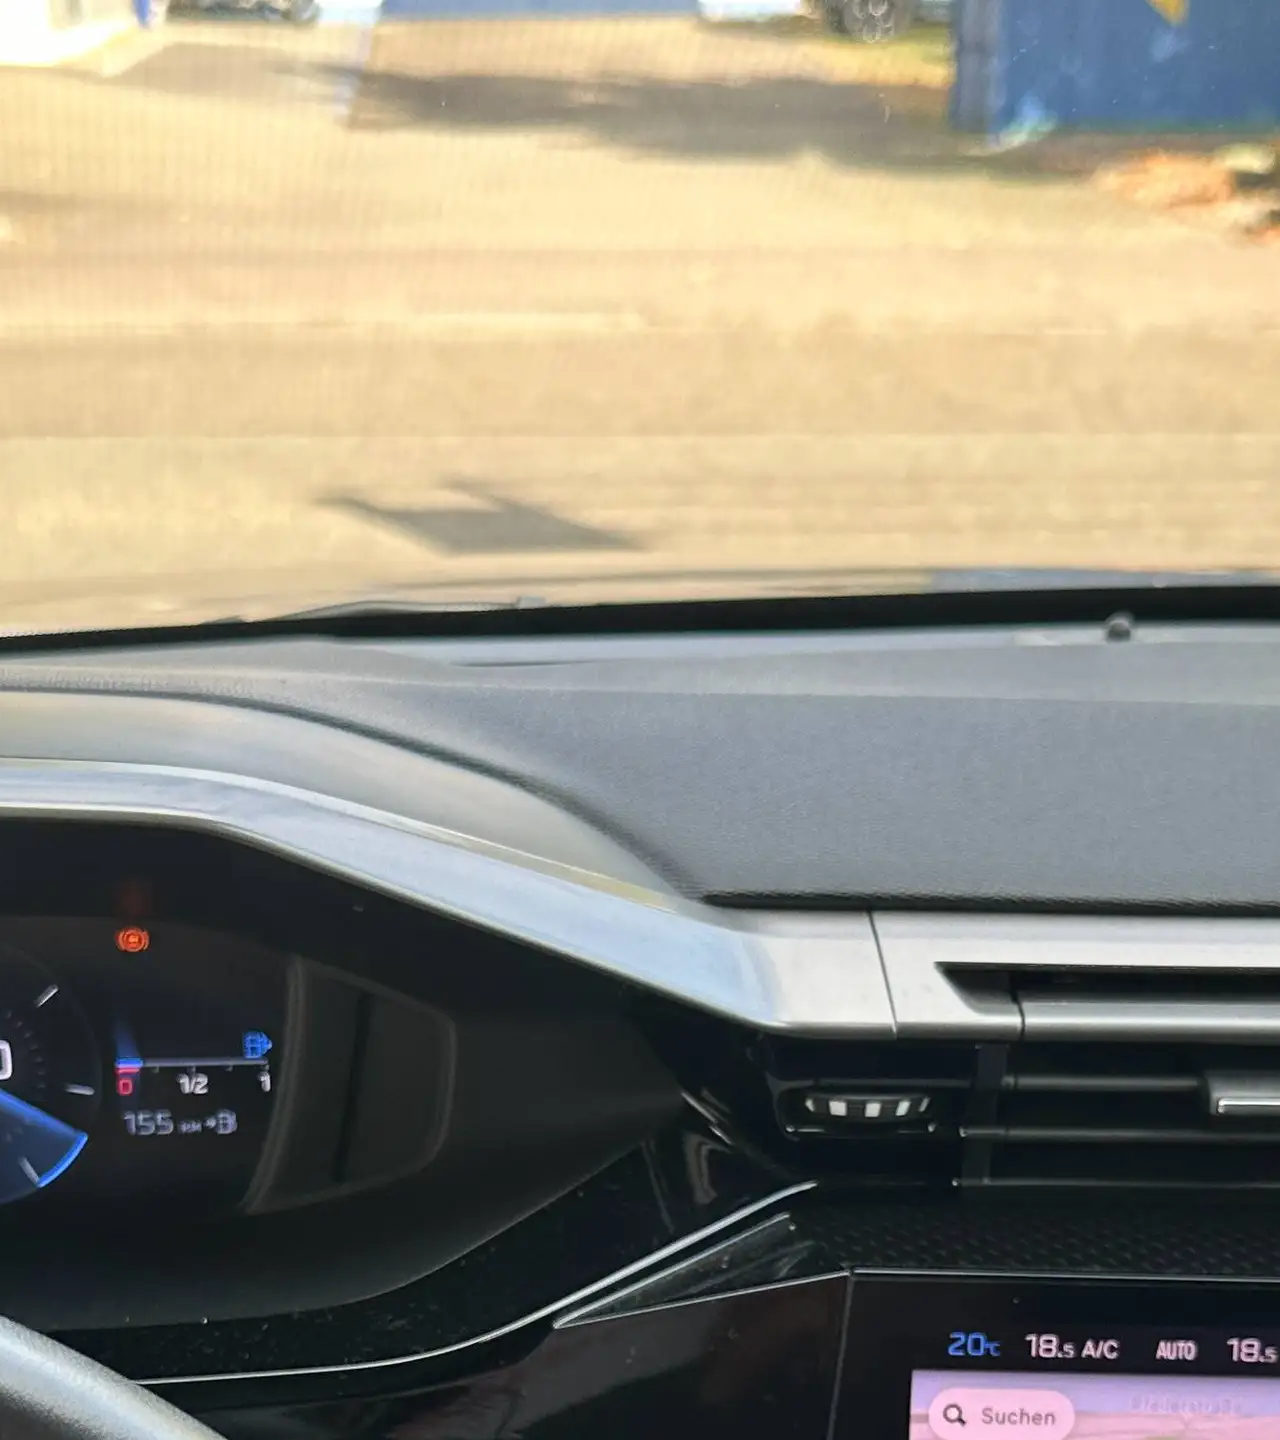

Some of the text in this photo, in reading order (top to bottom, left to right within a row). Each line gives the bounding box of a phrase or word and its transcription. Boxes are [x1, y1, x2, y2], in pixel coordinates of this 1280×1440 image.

[115, 1077, 134, 1096] 0
[177, 1072, 209, 1095] 1/2
[257, 1071, 271, 1093] 1
[123, 1109, 174, 1136] 155
[1025, 1333, 1119, 1360] 18.5 A/C
[1155, 1339, 1199, 1361] AUTO
[1226, 1336, 1279, 1364] 18.5
[980, 1407, 1057, 1427] Suchen
